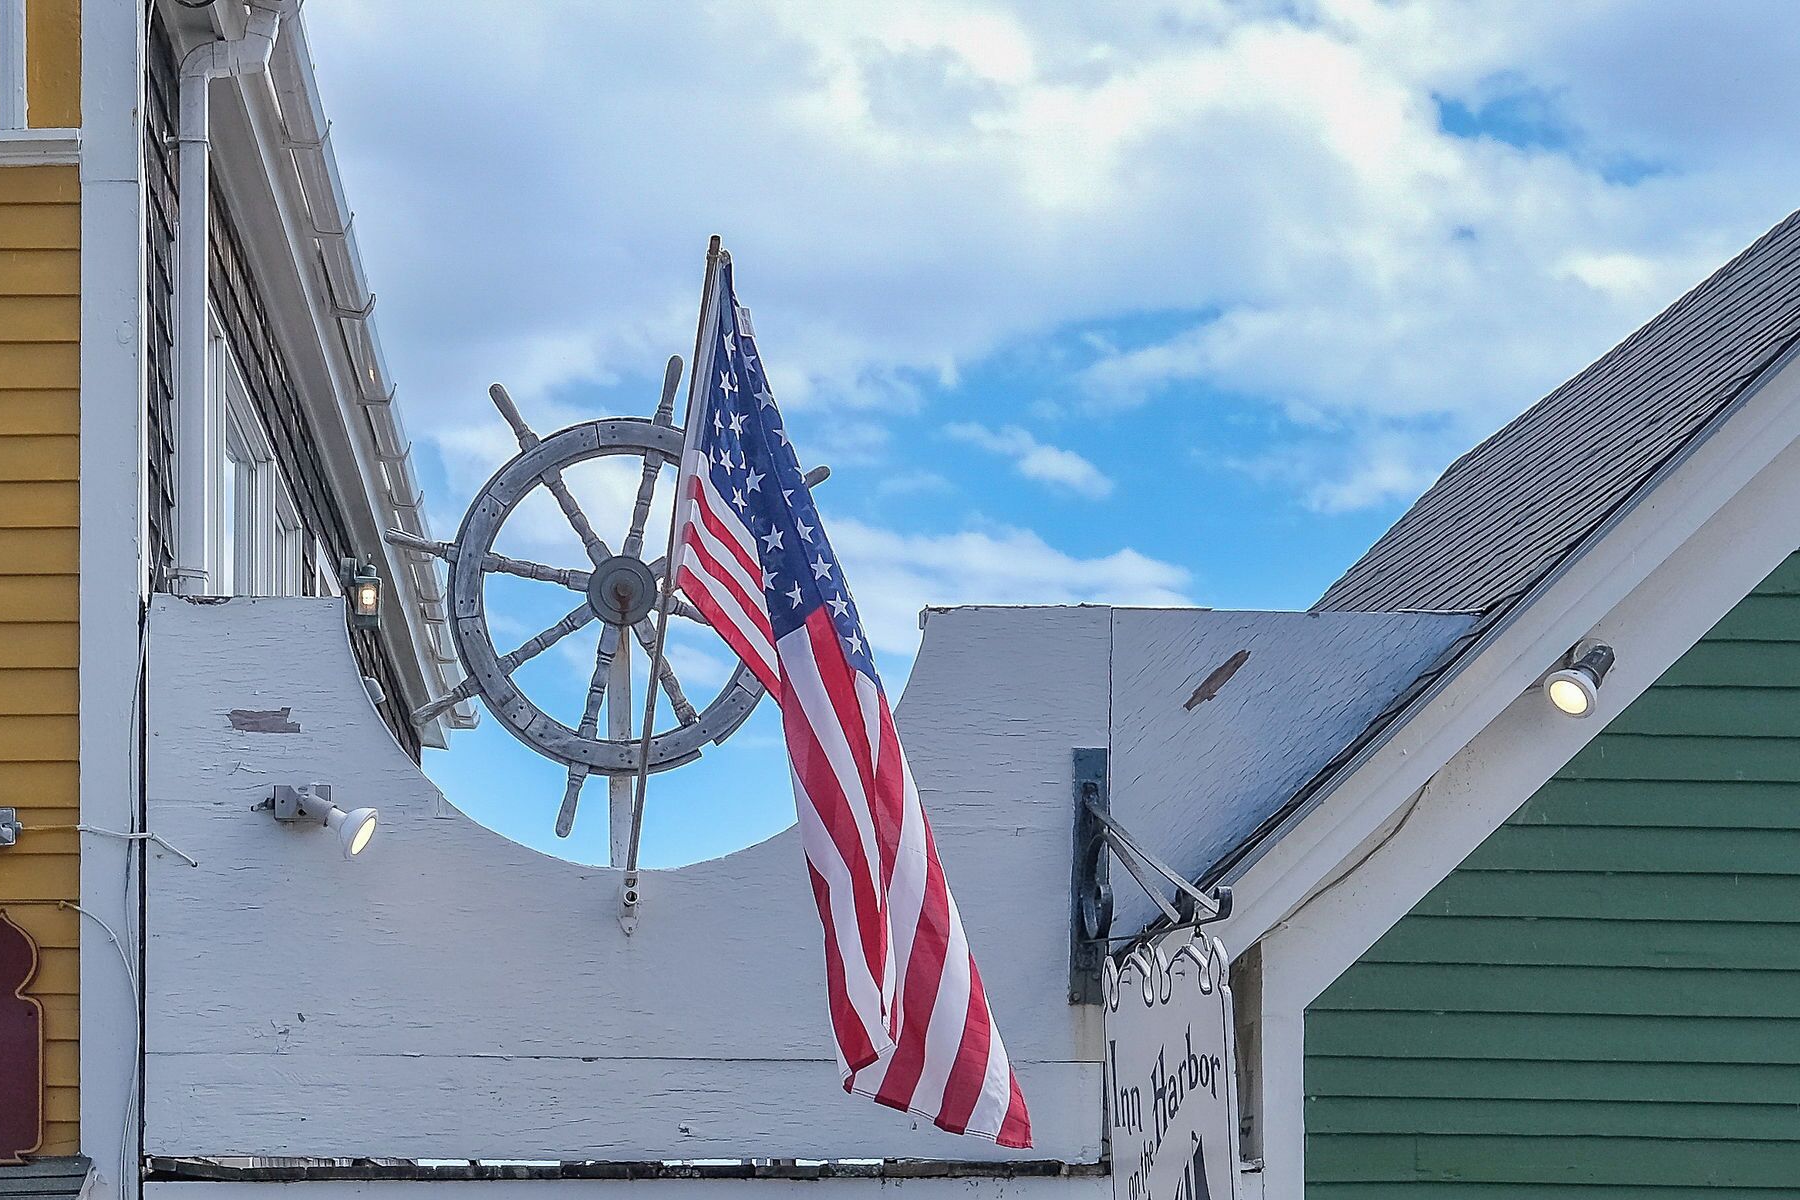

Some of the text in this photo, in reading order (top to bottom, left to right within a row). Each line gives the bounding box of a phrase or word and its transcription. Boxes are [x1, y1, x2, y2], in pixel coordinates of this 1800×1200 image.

[1109, 1022, 1221, 1155] Inn Harbor
[1141, 1139, 1154, 1194] the
